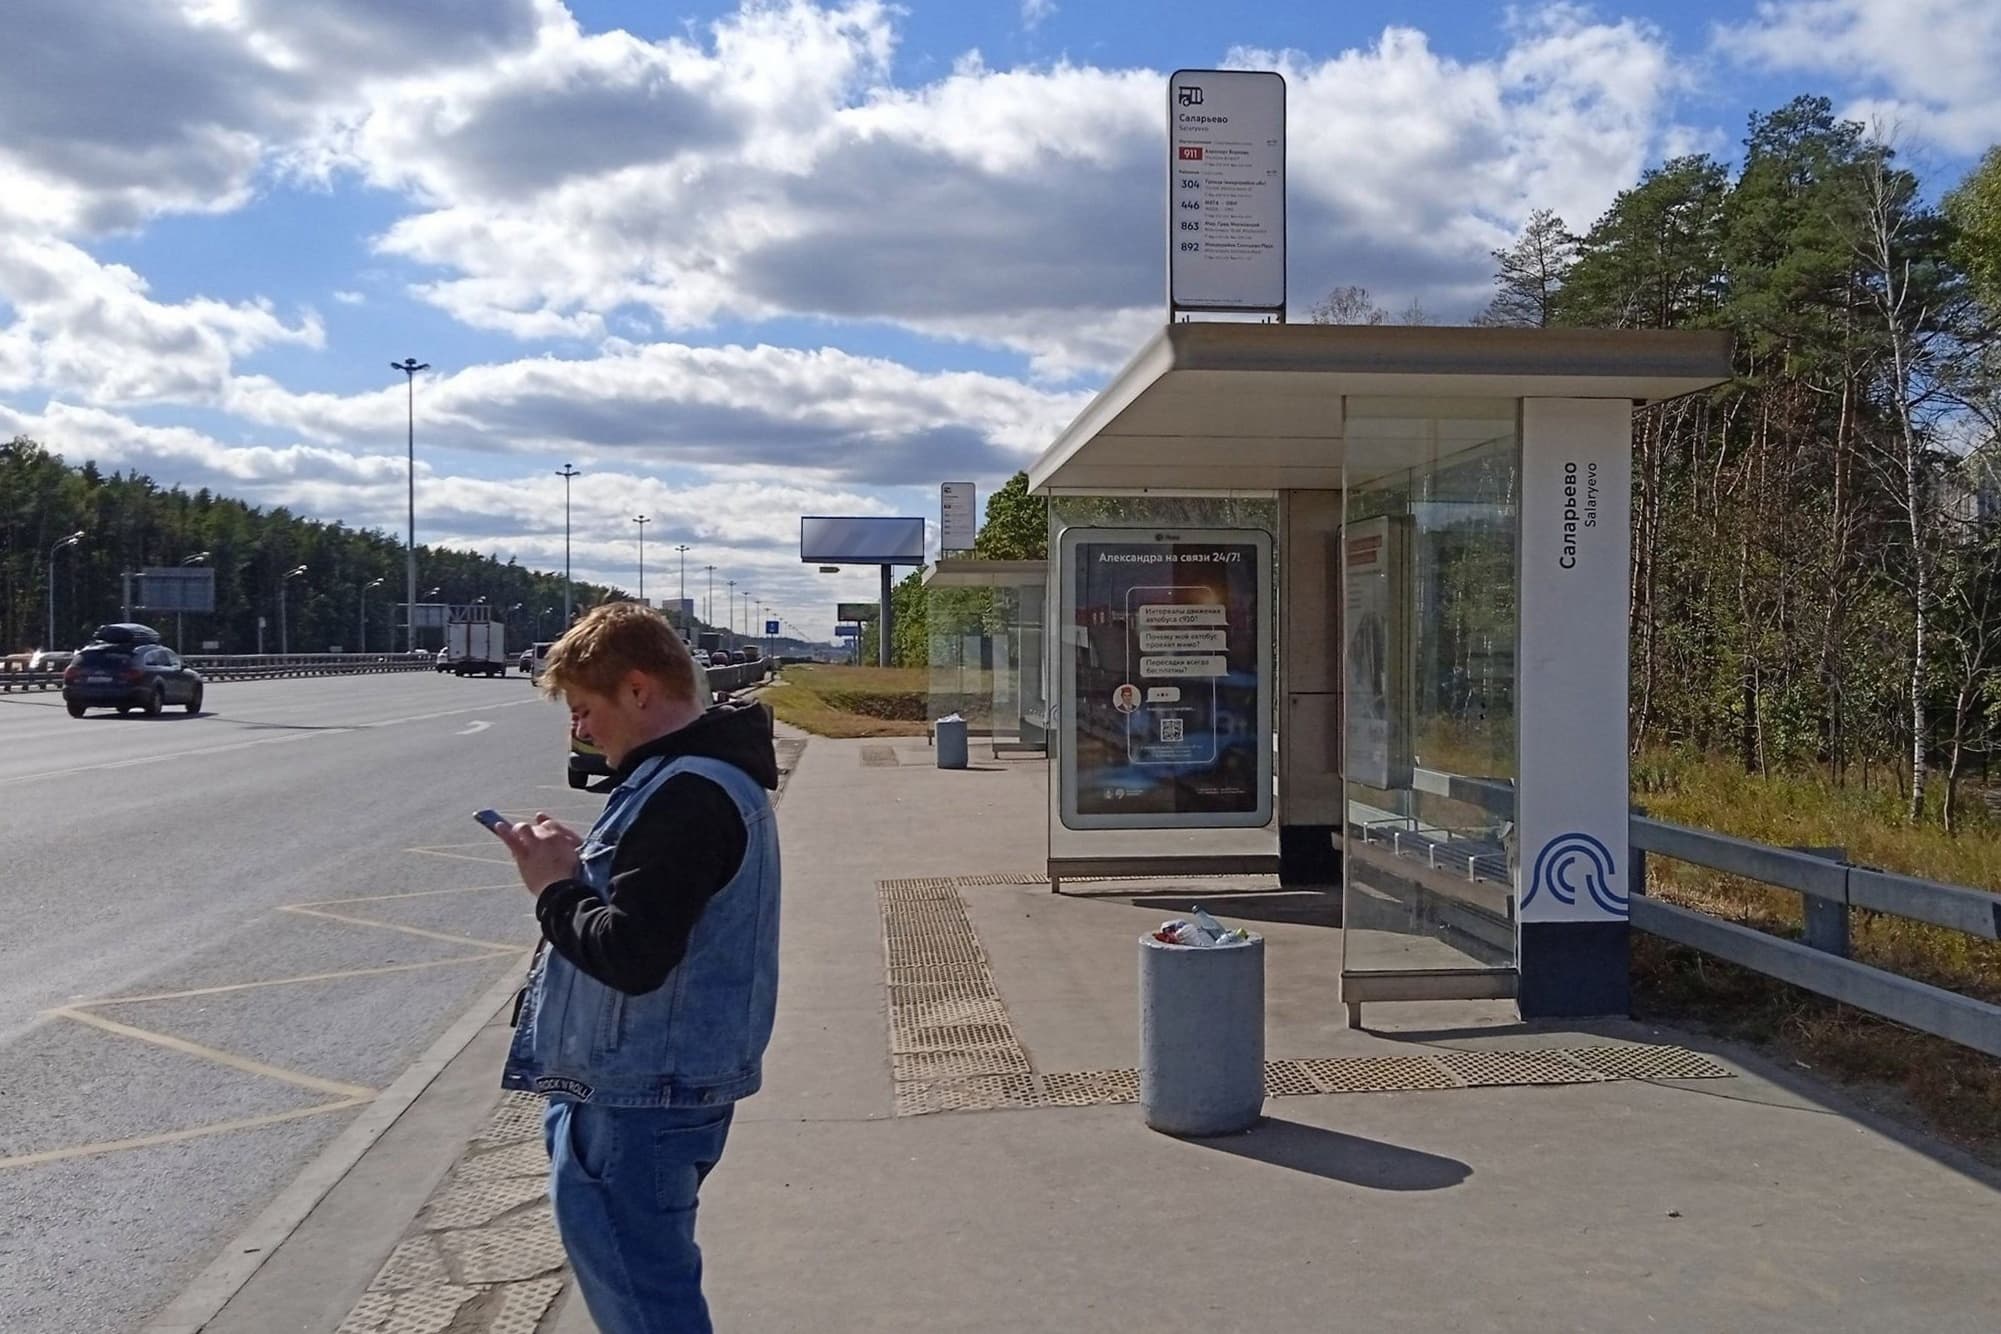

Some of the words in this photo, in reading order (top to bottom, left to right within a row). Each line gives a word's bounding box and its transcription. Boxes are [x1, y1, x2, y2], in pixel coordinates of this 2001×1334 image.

[1179, 113, 1229, 124] Саларьево
[1184, 149, 1198, 158] 911
[1181, 180, 1200, 189] 304
[1181, 201, 1200, 210] 446
[1180, 221, 1199, 231] 863
[1180, 242, 1199, 252] 892
[1584, 462, 1599, 528] Salaryevo
[1559, 462, 1580, 569] Саларьево
[1098, 552, 1163, 563] Александра
[1166, 554, 1178, 562] на
[1180, 554, 1210, 562] связи
[1212, 552, 1241, 563] 24/7!
